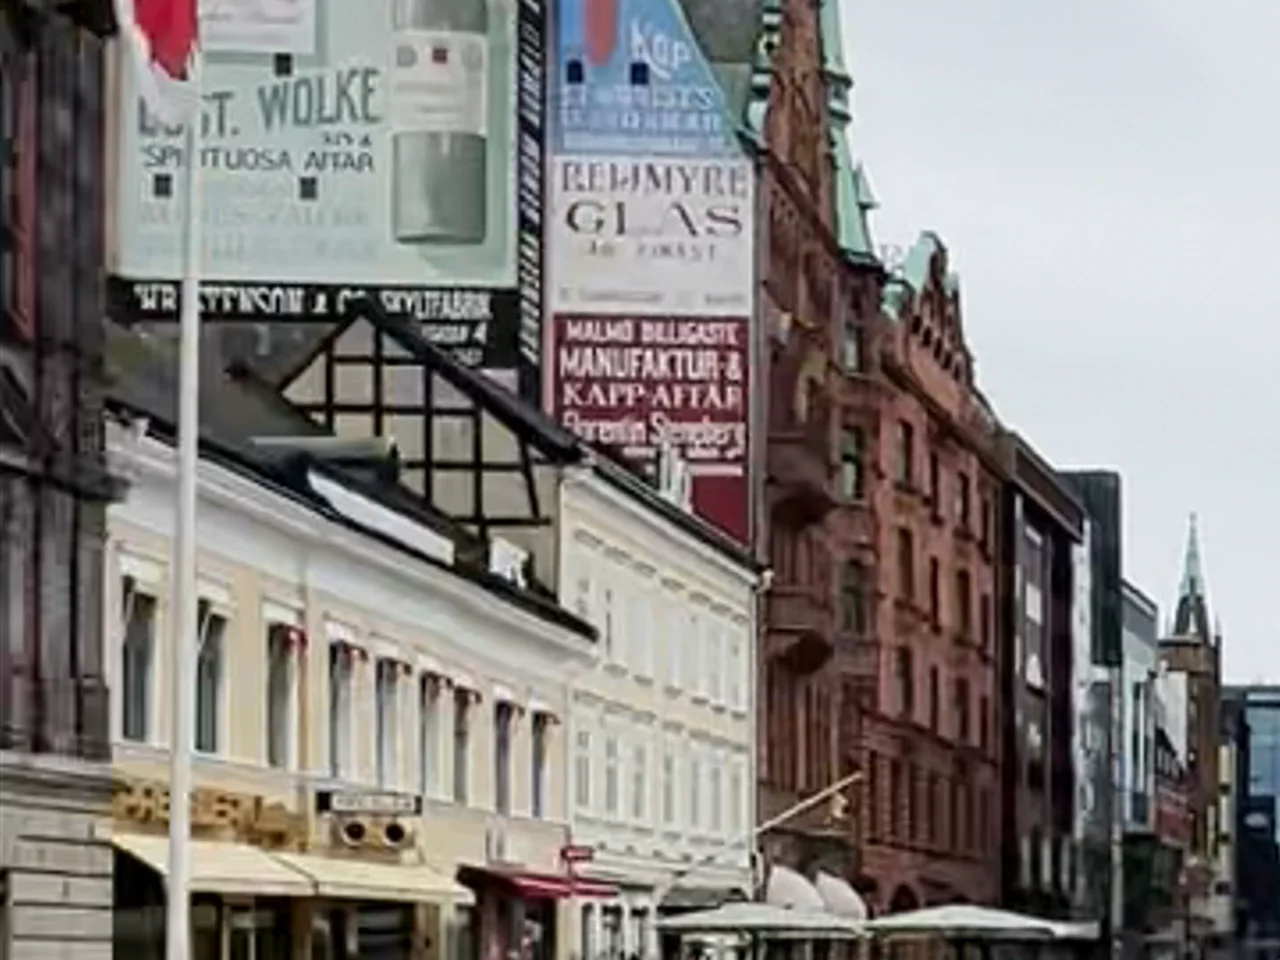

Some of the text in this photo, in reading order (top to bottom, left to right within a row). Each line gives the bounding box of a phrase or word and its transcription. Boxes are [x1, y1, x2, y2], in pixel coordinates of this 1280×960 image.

[257, 67, 381, 132] WOLKE
[142, 146, 293, 171] SPIITUOSA
[565, 201, 743, 237] GLAS
